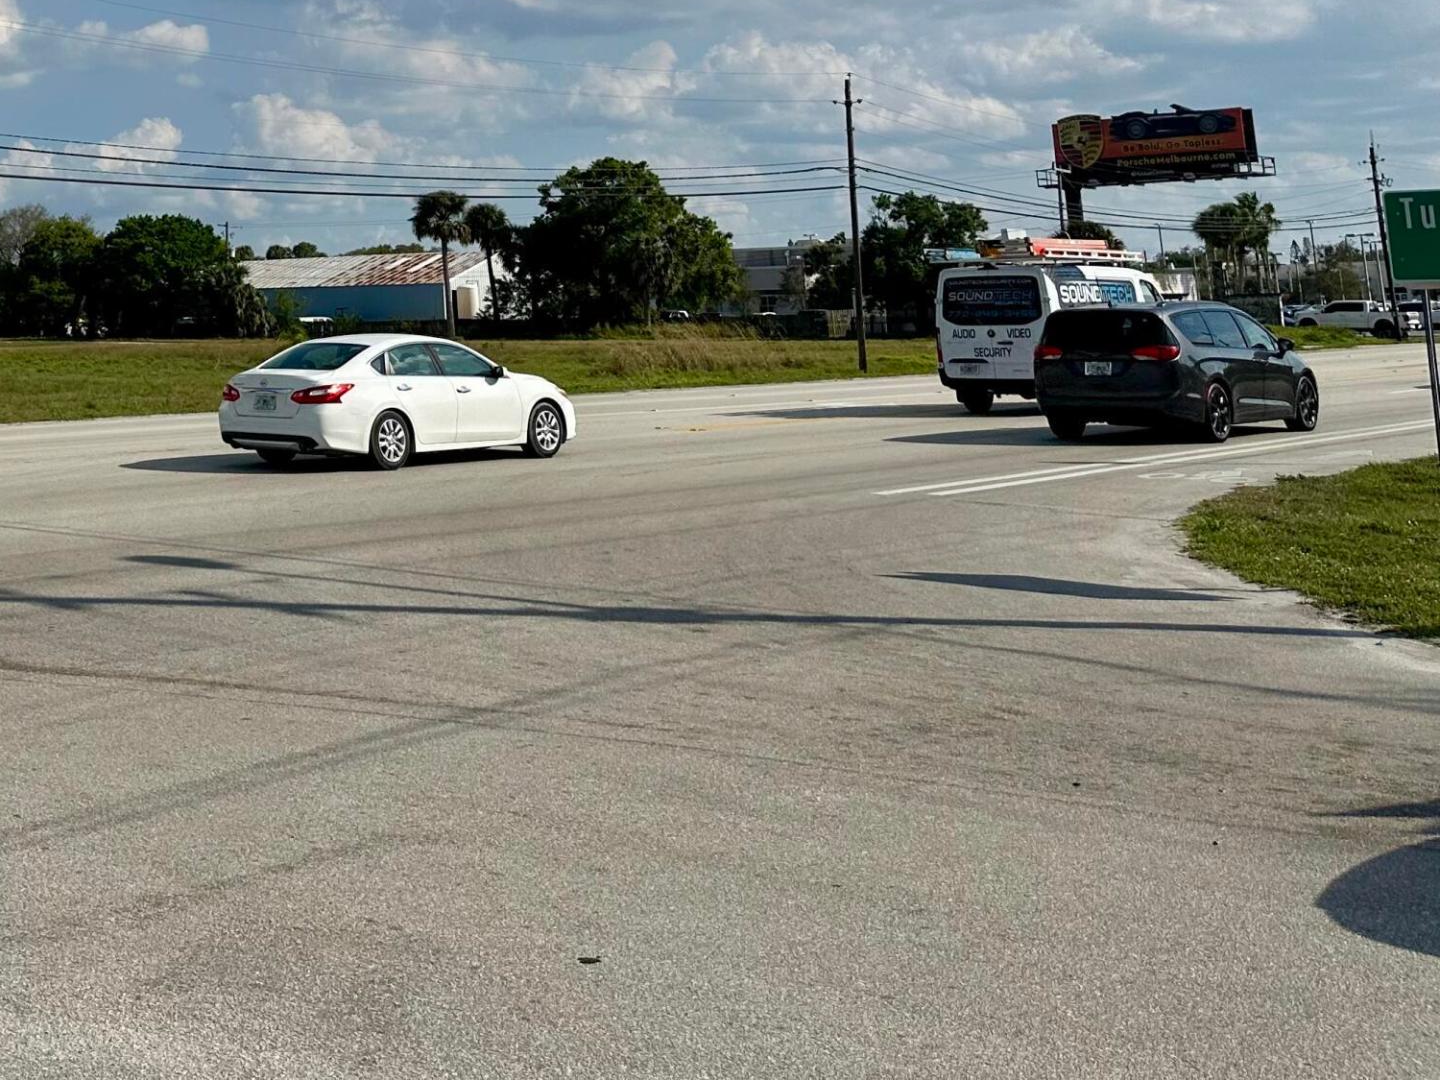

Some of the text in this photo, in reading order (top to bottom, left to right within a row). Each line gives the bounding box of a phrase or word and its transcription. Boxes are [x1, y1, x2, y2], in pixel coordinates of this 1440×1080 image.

[1123, 144, 1135, 153] Be
[1166, 140, 1180, 149] Go
[1117, 151, 1236, 167] PorscheMelbourne.com
[952, 328, 1032, 338] AUDIO VIDEO
[973, 347, 1012, 357] SECURITY
